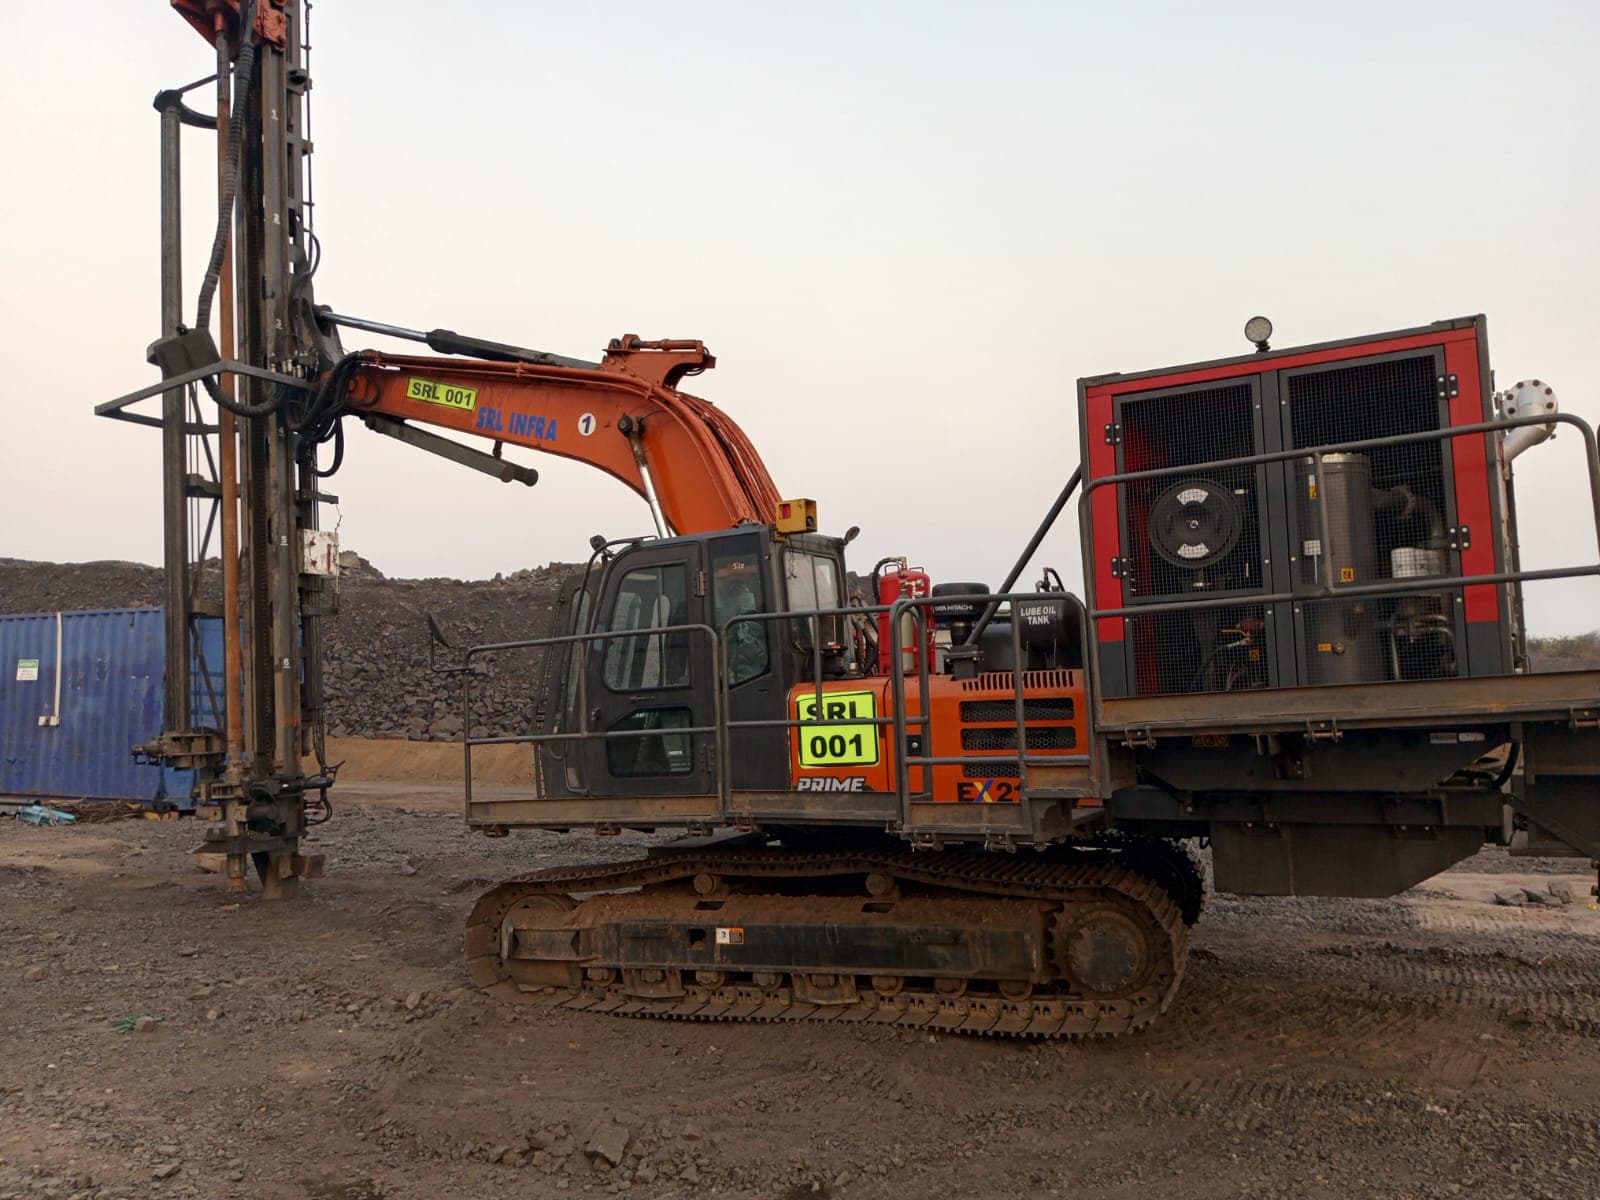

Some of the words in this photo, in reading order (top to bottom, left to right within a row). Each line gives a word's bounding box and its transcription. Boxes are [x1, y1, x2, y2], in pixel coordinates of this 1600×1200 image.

[411, 381, 440, 401] SRL
[445, 388, 472, 407] 001
[476, 405, 504, 432] SRL
[508, 412, 558, 441] INFRA
[582, 415, 593, 434] 1
[1020, 607, 1042, 617] LUBE
[1042, 605, 1057, 615] OIL
[1027, 615, 1050, 625] TANK
[806, 701, 867, 722] SRL
[810, 734, 863, 758] 001
[797, 777, 865, 792] PRIME
